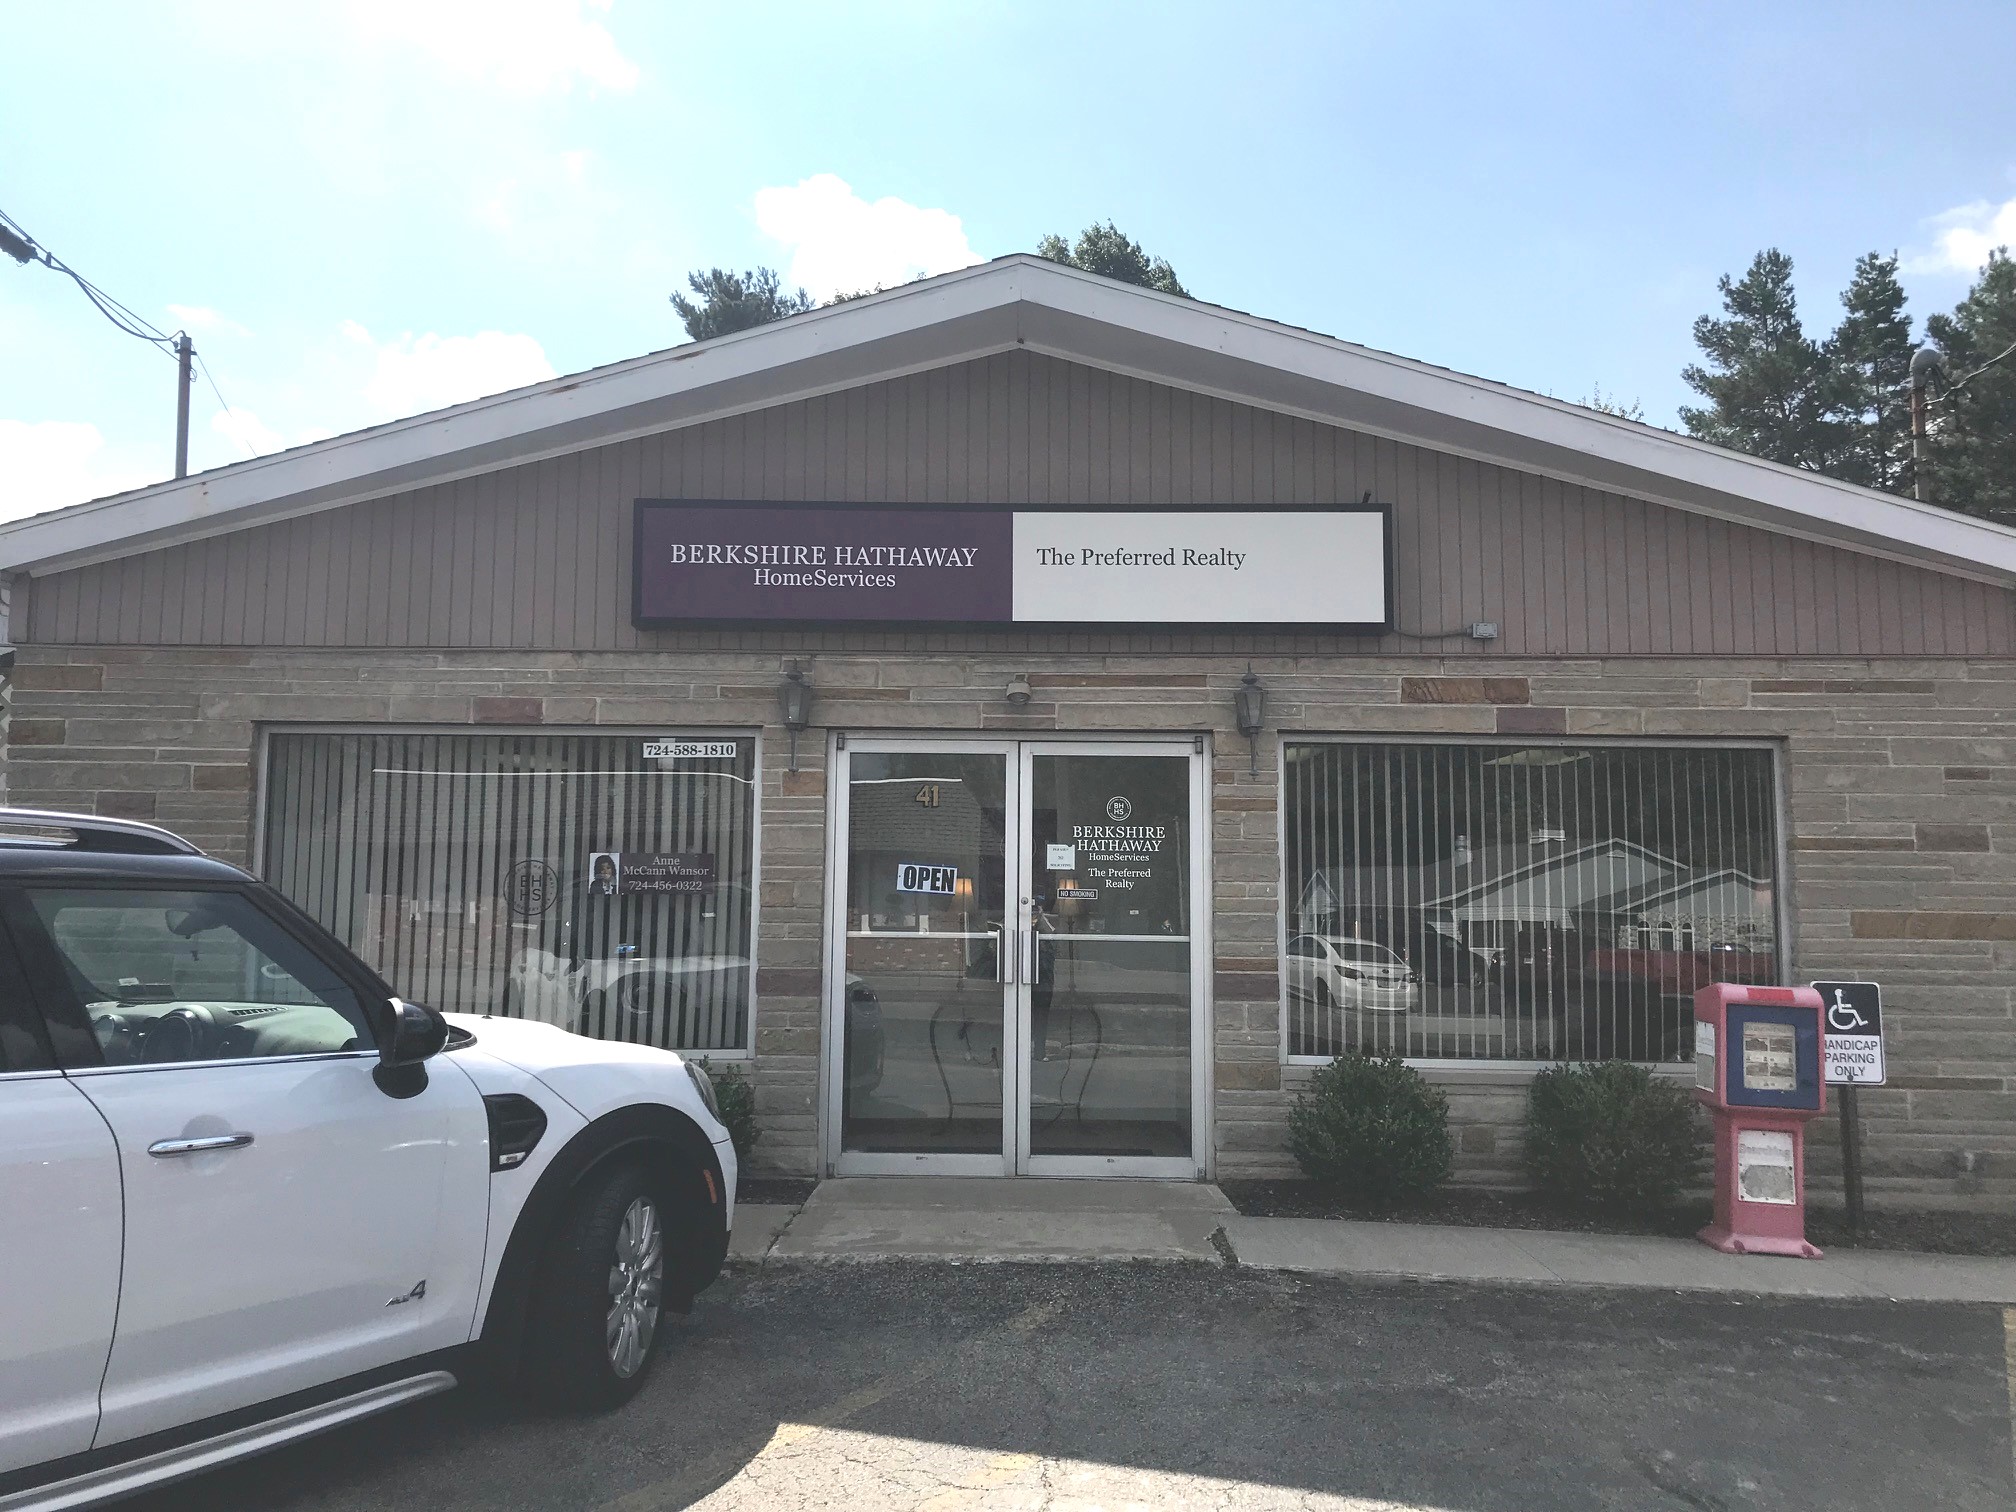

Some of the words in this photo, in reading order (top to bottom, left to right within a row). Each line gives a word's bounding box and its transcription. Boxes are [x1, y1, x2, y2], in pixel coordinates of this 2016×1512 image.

[670, 544, 827, 566] BERKSHIRE
[834, 546, 978, 567] HATHAWAY
[1036, 548, 1075, 567] The
[1081, 547, 1176, 567] Preferred
[1182, 548, 1247, 571] Realty
[753, 568, 897, 588] HomeServices
[645, 744, 735, 756] 724-588-1810
[915, 784, 940, 808] 41
[1072, 825, 1166, 839] BERKSHIRE
[1077, 839, 1162, 852] HATHAWAY
[652, 855, 681, 866] Anne
[1088, 852, 1150, 862] HomeServices
[623, 865, 666, 876] McCann
[669, 865, 710, 876] Wansor
[1088, 867, 1106, 877] The
[1108, 867, 1152, 878] Preferred
[903, 865, 956, 893] OPEN
[1105, 879, 1135, 891] Realty
[628, 880, 703, 891] 724-456-0322
[1060, 890, 1069, 898] NO
[1069, 890, 1095, 898] SMOKING
[1824, 1052, 1875, 1064] PARKING
[1834, 1065, 1866, 1077] ONLY
